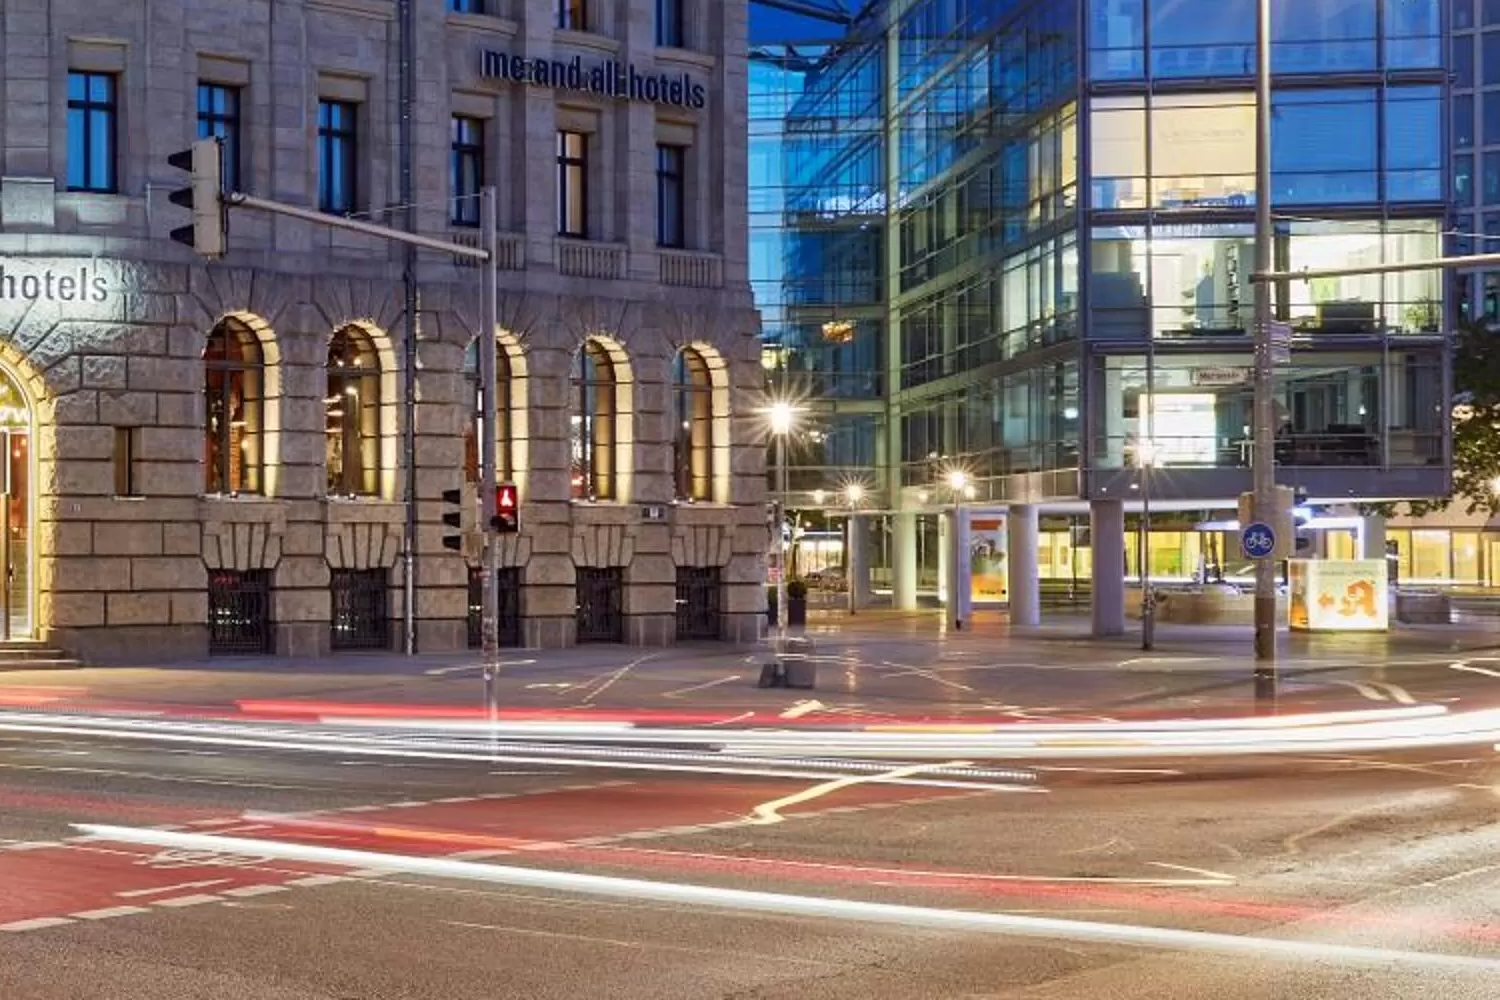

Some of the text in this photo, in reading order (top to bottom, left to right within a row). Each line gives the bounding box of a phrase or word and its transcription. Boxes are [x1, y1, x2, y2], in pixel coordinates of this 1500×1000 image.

[479, 47, 706, 110] me and all hotels
